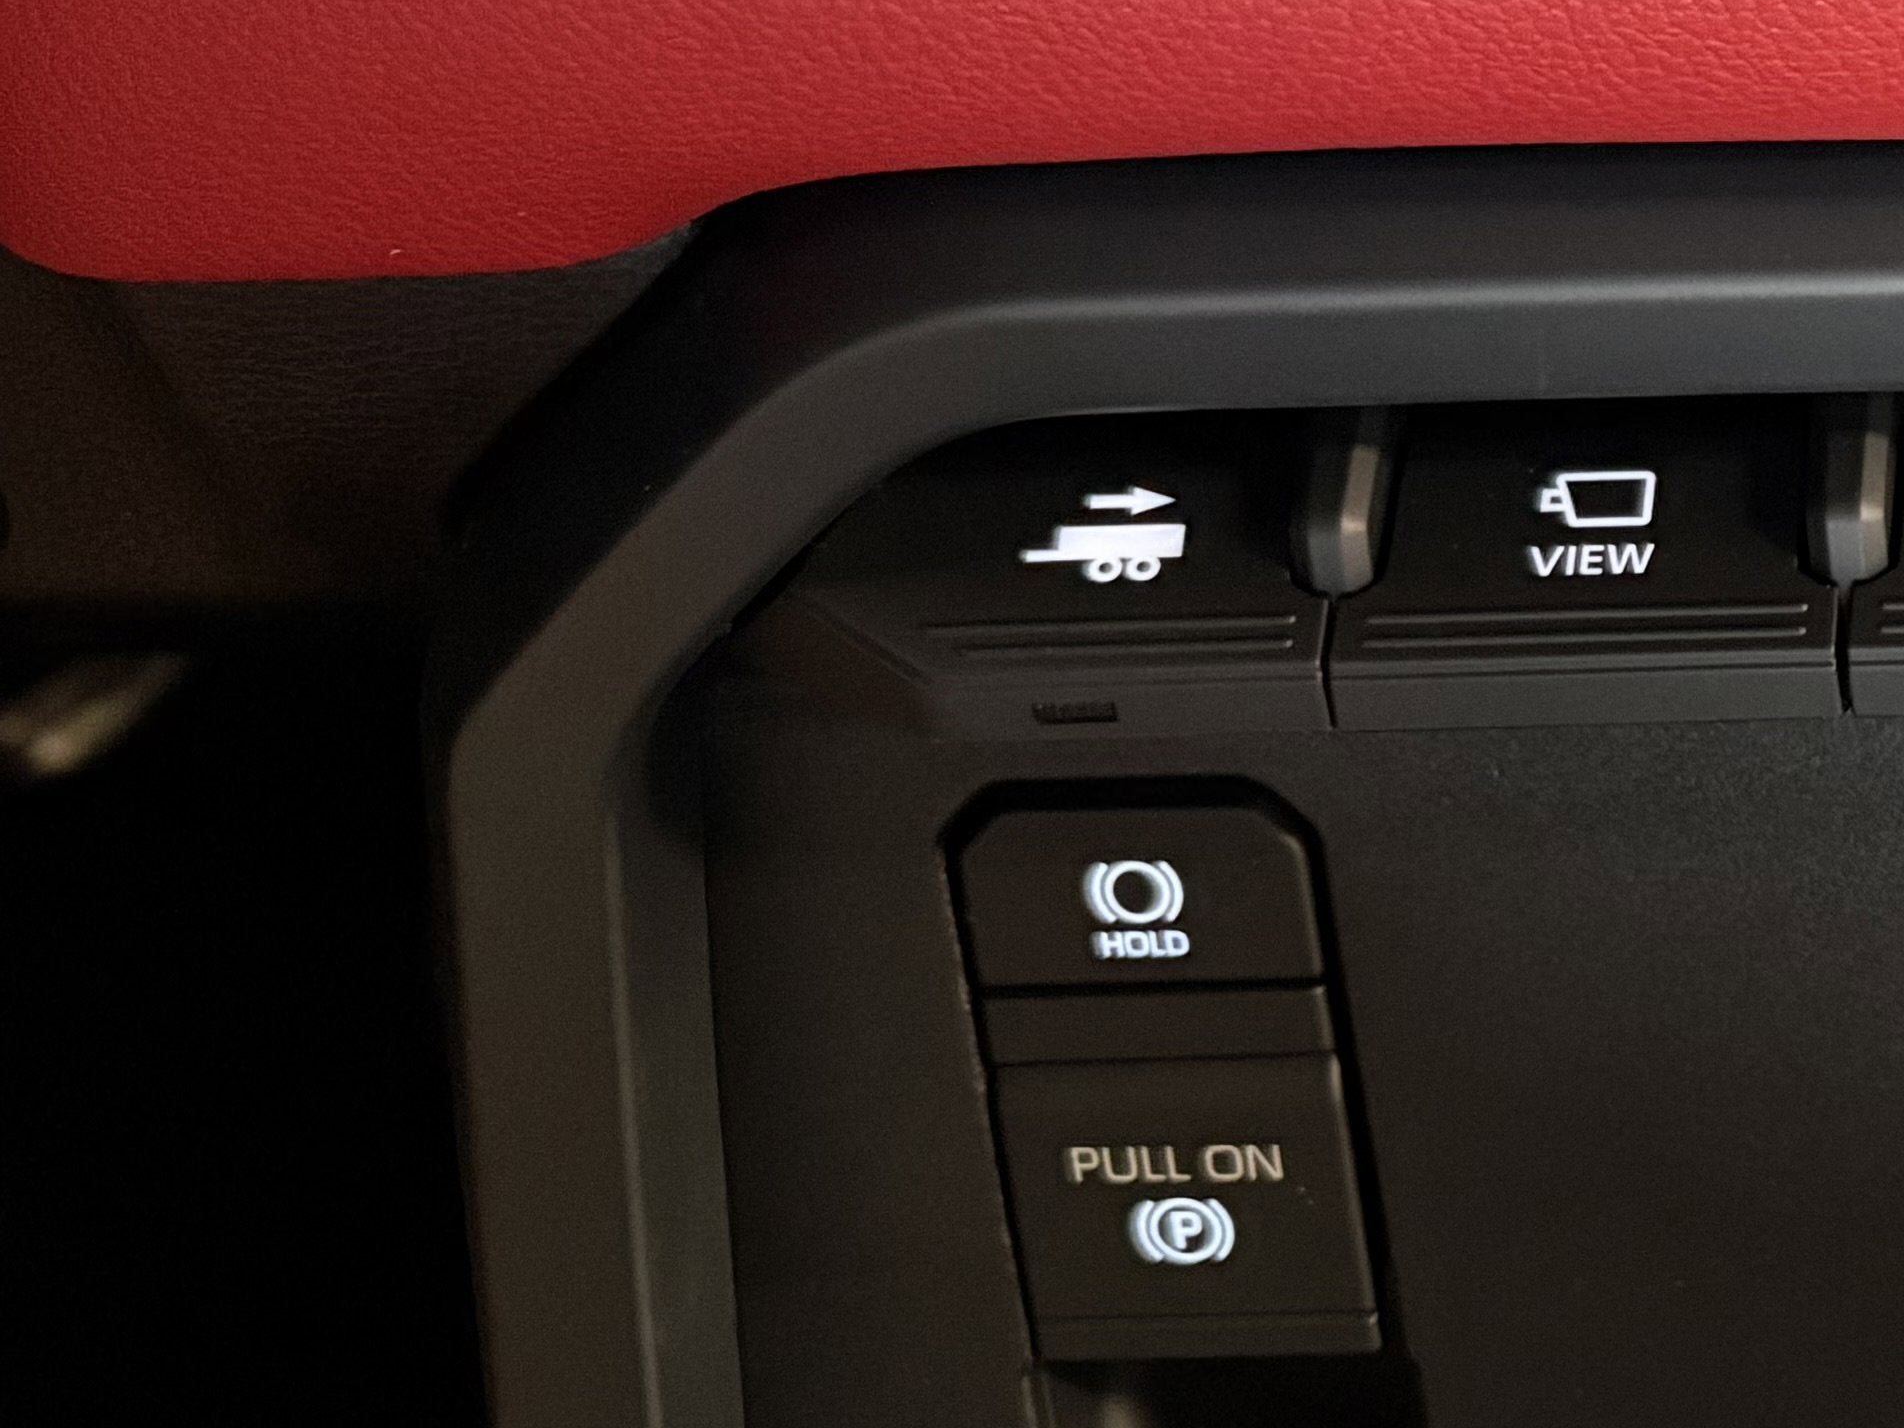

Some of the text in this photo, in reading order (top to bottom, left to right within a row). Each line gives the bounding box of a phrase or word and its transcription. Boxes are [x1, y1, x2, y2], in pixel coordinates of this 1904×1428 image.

[1528, 541, 1657, 579] VIEW
[1097, 929, 1191, 959] HOLD
[1068, 1143, 1285, 1185] PULL ON
